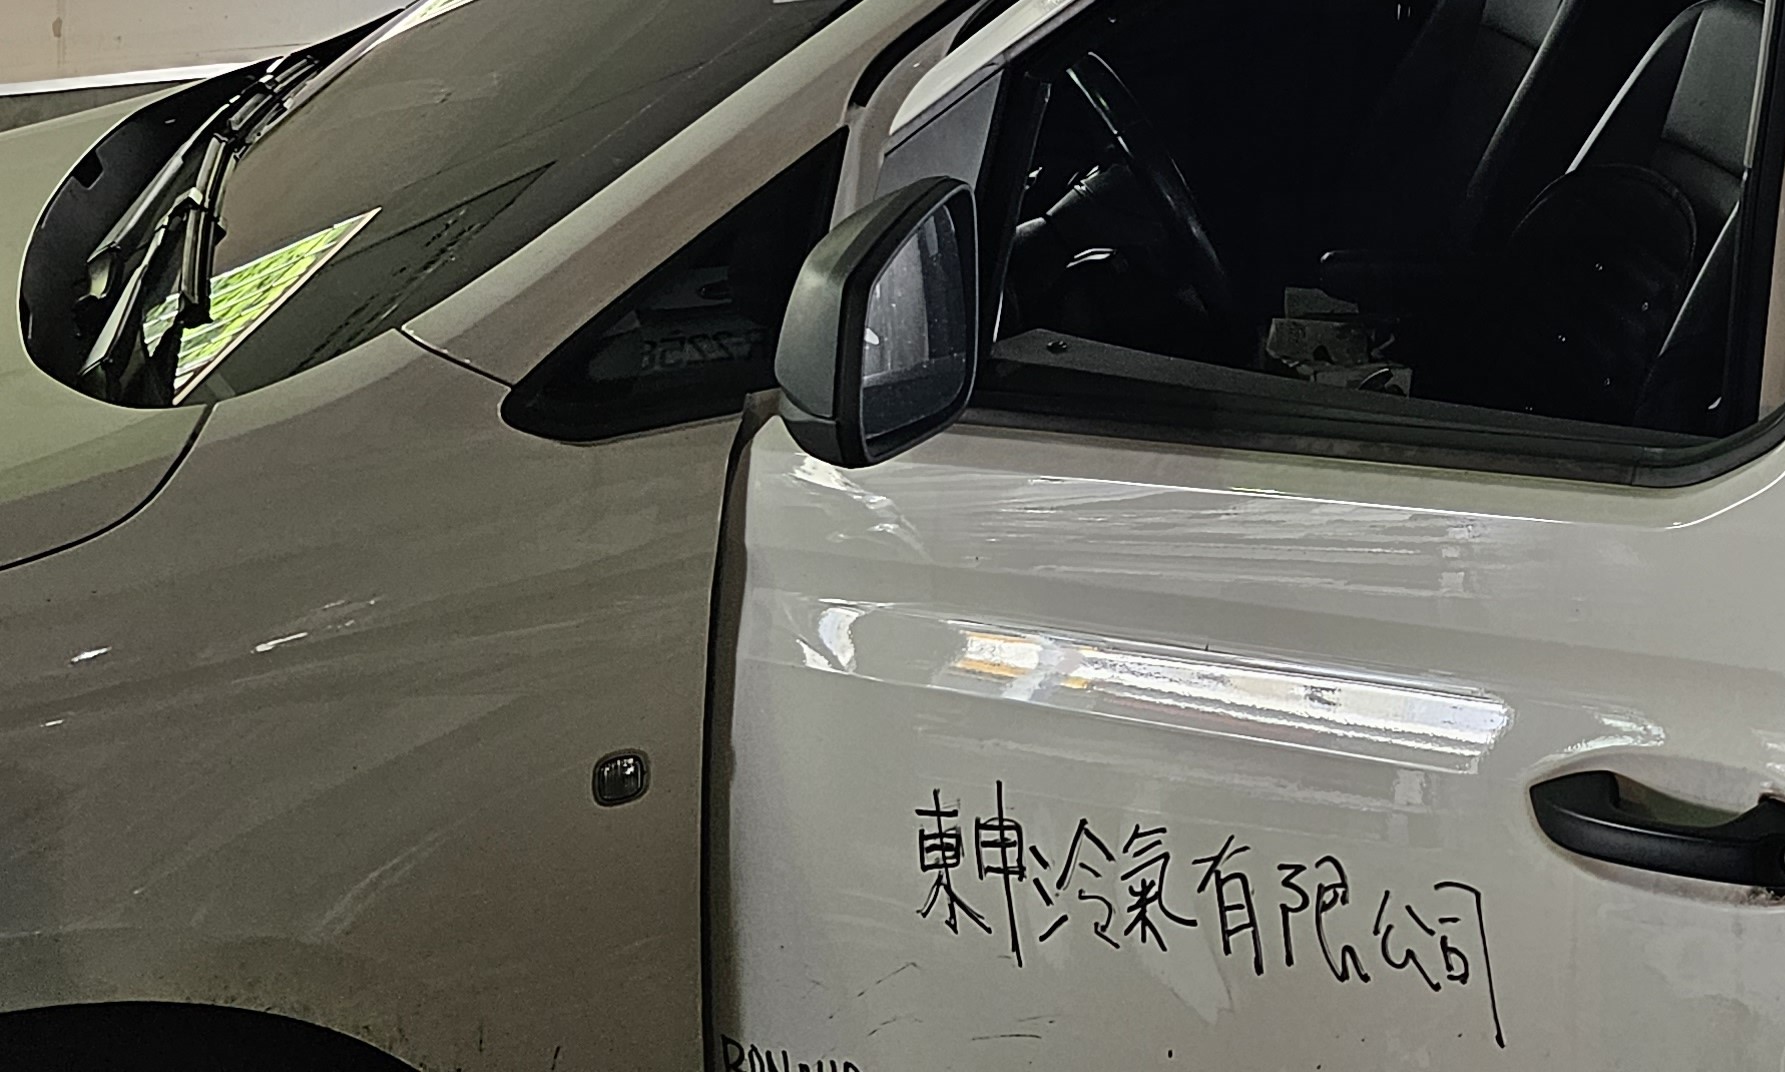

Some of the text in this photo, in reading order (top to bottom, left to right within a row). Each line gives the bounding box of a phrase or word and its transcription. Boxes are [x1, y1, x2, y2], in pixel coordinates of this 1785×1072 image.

[914, 779, 1505, 1050] 東申冷氣有限公司
